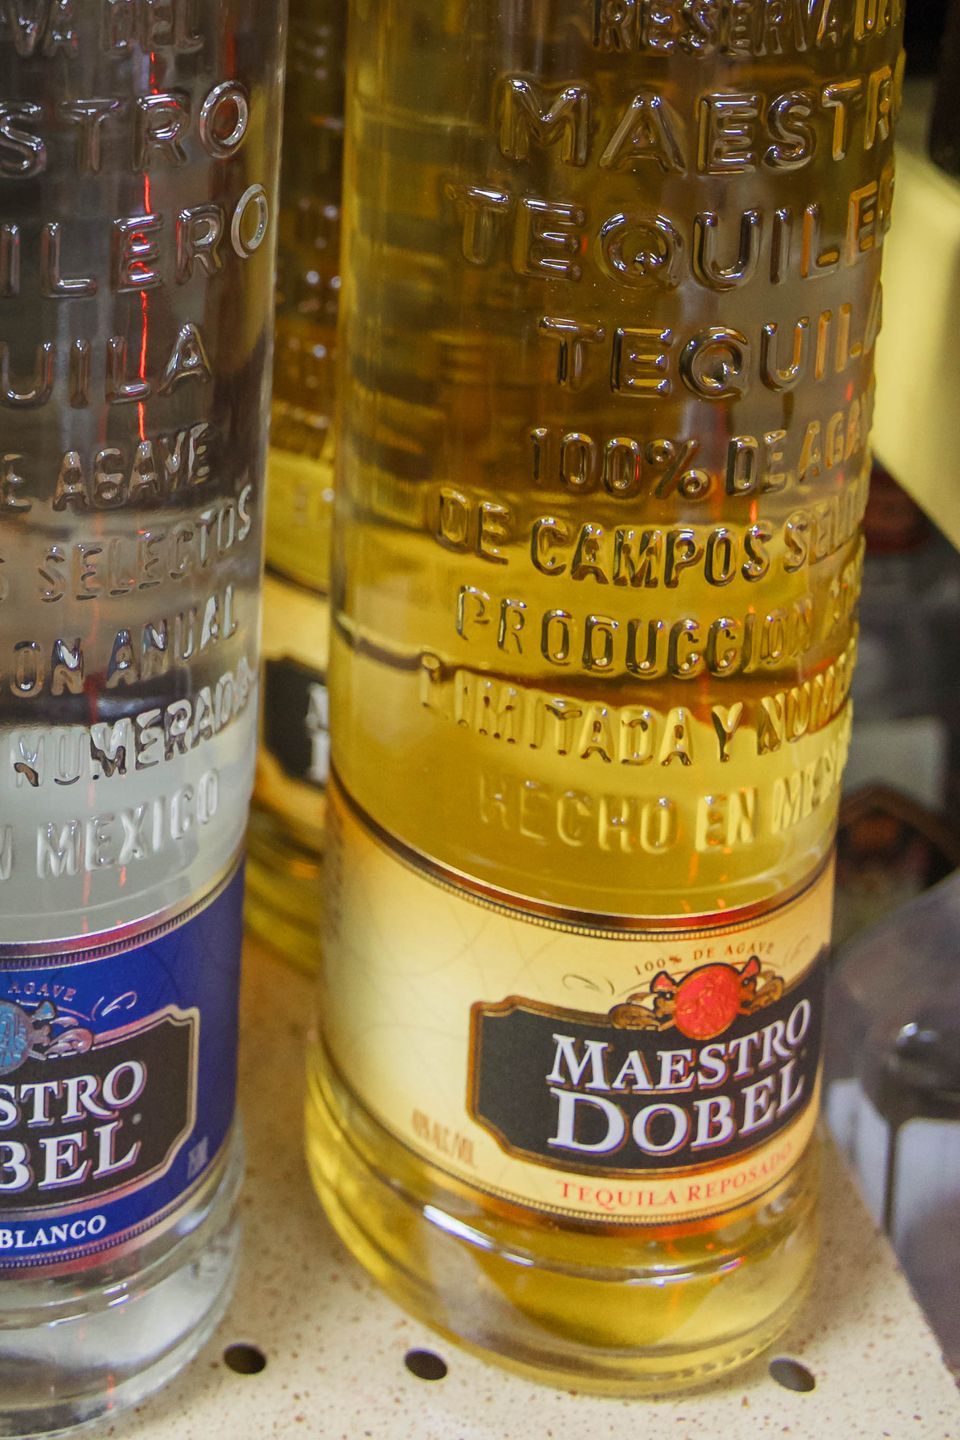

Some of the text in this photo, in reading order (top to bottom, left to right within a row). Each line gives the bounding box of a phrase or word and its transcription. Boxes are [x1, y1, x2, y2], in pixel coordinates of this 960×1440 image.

[497, 49, 906, 178] MAESTR
[52, 420, 212, 513] AGAVE
[528, 426, 711, 501] 100%
[724, 428, 788, 497] DE
[37, 482, 253, 604] SELECTOS
[437, 486, 511, 566] DE
[529, 514, 773, 590] CAMPOS
[103, 582, 240, 690] ANUAL
[455, 583, 814, 679] PRODUCCION
[9, 656, 259, 788] NUMERADA
[710, 701, 744, 764] Y
[35, 767, 221, 880] MEXICO
[476, 771, 678, 856] HECHO
[694, 786, 760, 855] EN
[7, 981, 78, 1002] AGAVE
[693, 947, 716, 961] DE
[726, 941, 775, 956] AGAVE
[546, 998, 812, 1093] MAESTRO
[546, 1060, 807, 1157] DOBEL
[555, 1141, 794, 1211] TEQUILA REPOSADO
